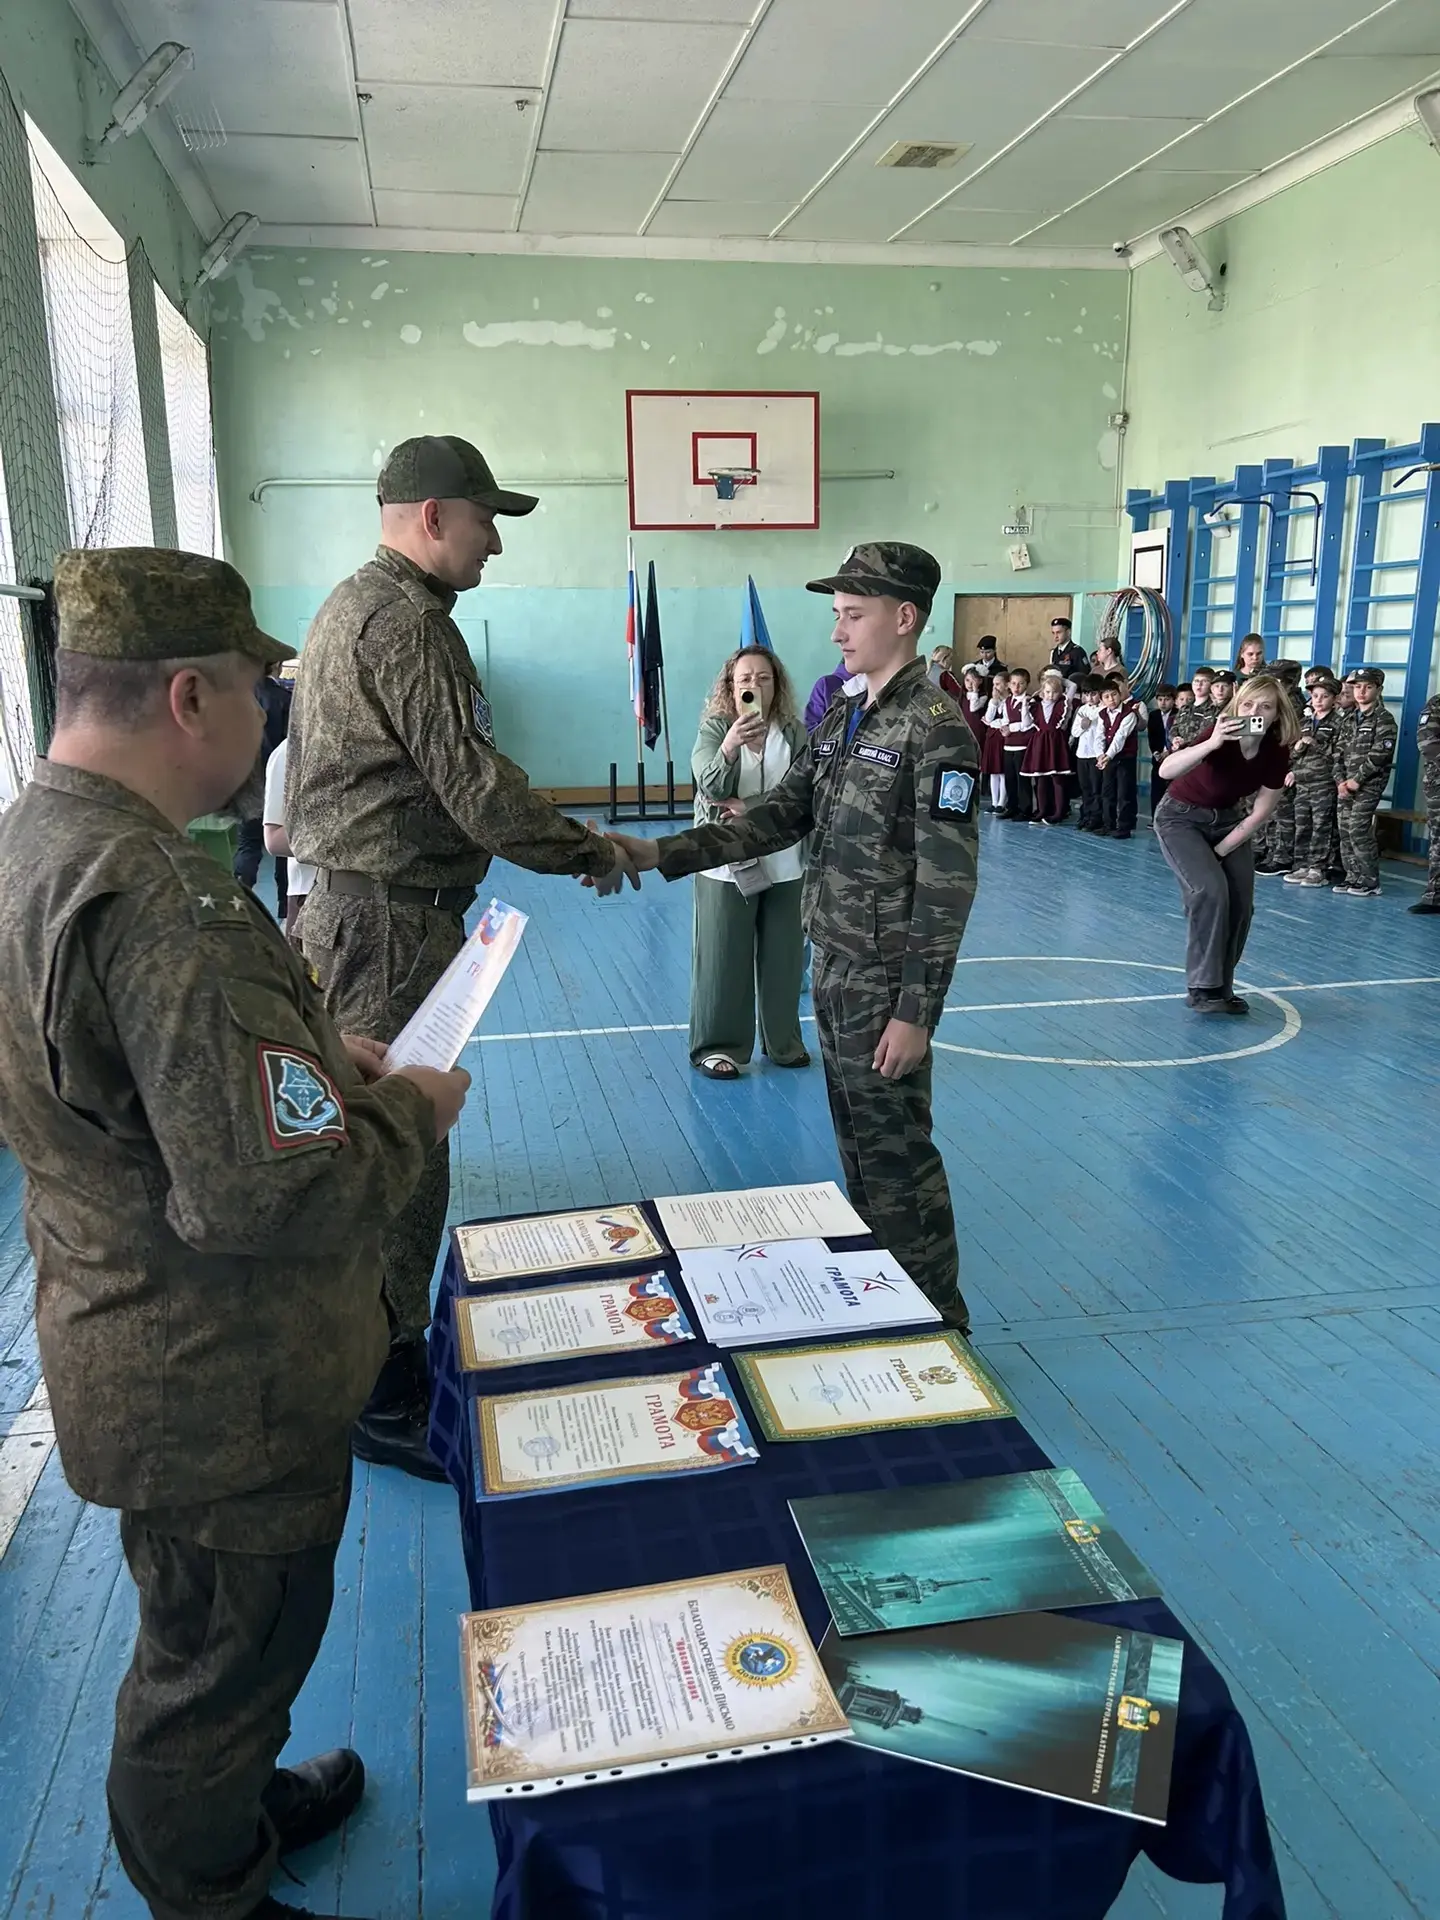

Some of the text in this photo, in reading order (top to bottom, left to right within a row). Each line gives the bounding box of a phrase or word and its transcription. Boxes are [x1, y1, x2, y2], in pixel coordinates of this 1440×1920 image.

[824, 1266, 861, 1307] ГРАМОТА
[599, 1293, 626, 1336] ГРАМОТА
[889, 1357, 926, 1402] ГРАМОТА
[645, 1393, 676, 1450] ГРАМОТА
[687, 1599, 736, 1731] БЛАГОДАРСТВЕННОЕ ПИСЬМО
[1102, 1697, 1114, 1727] ГОРОДА
[1091, 1727, 1110, 1795] ЕКАТЕРИНБУРГА
